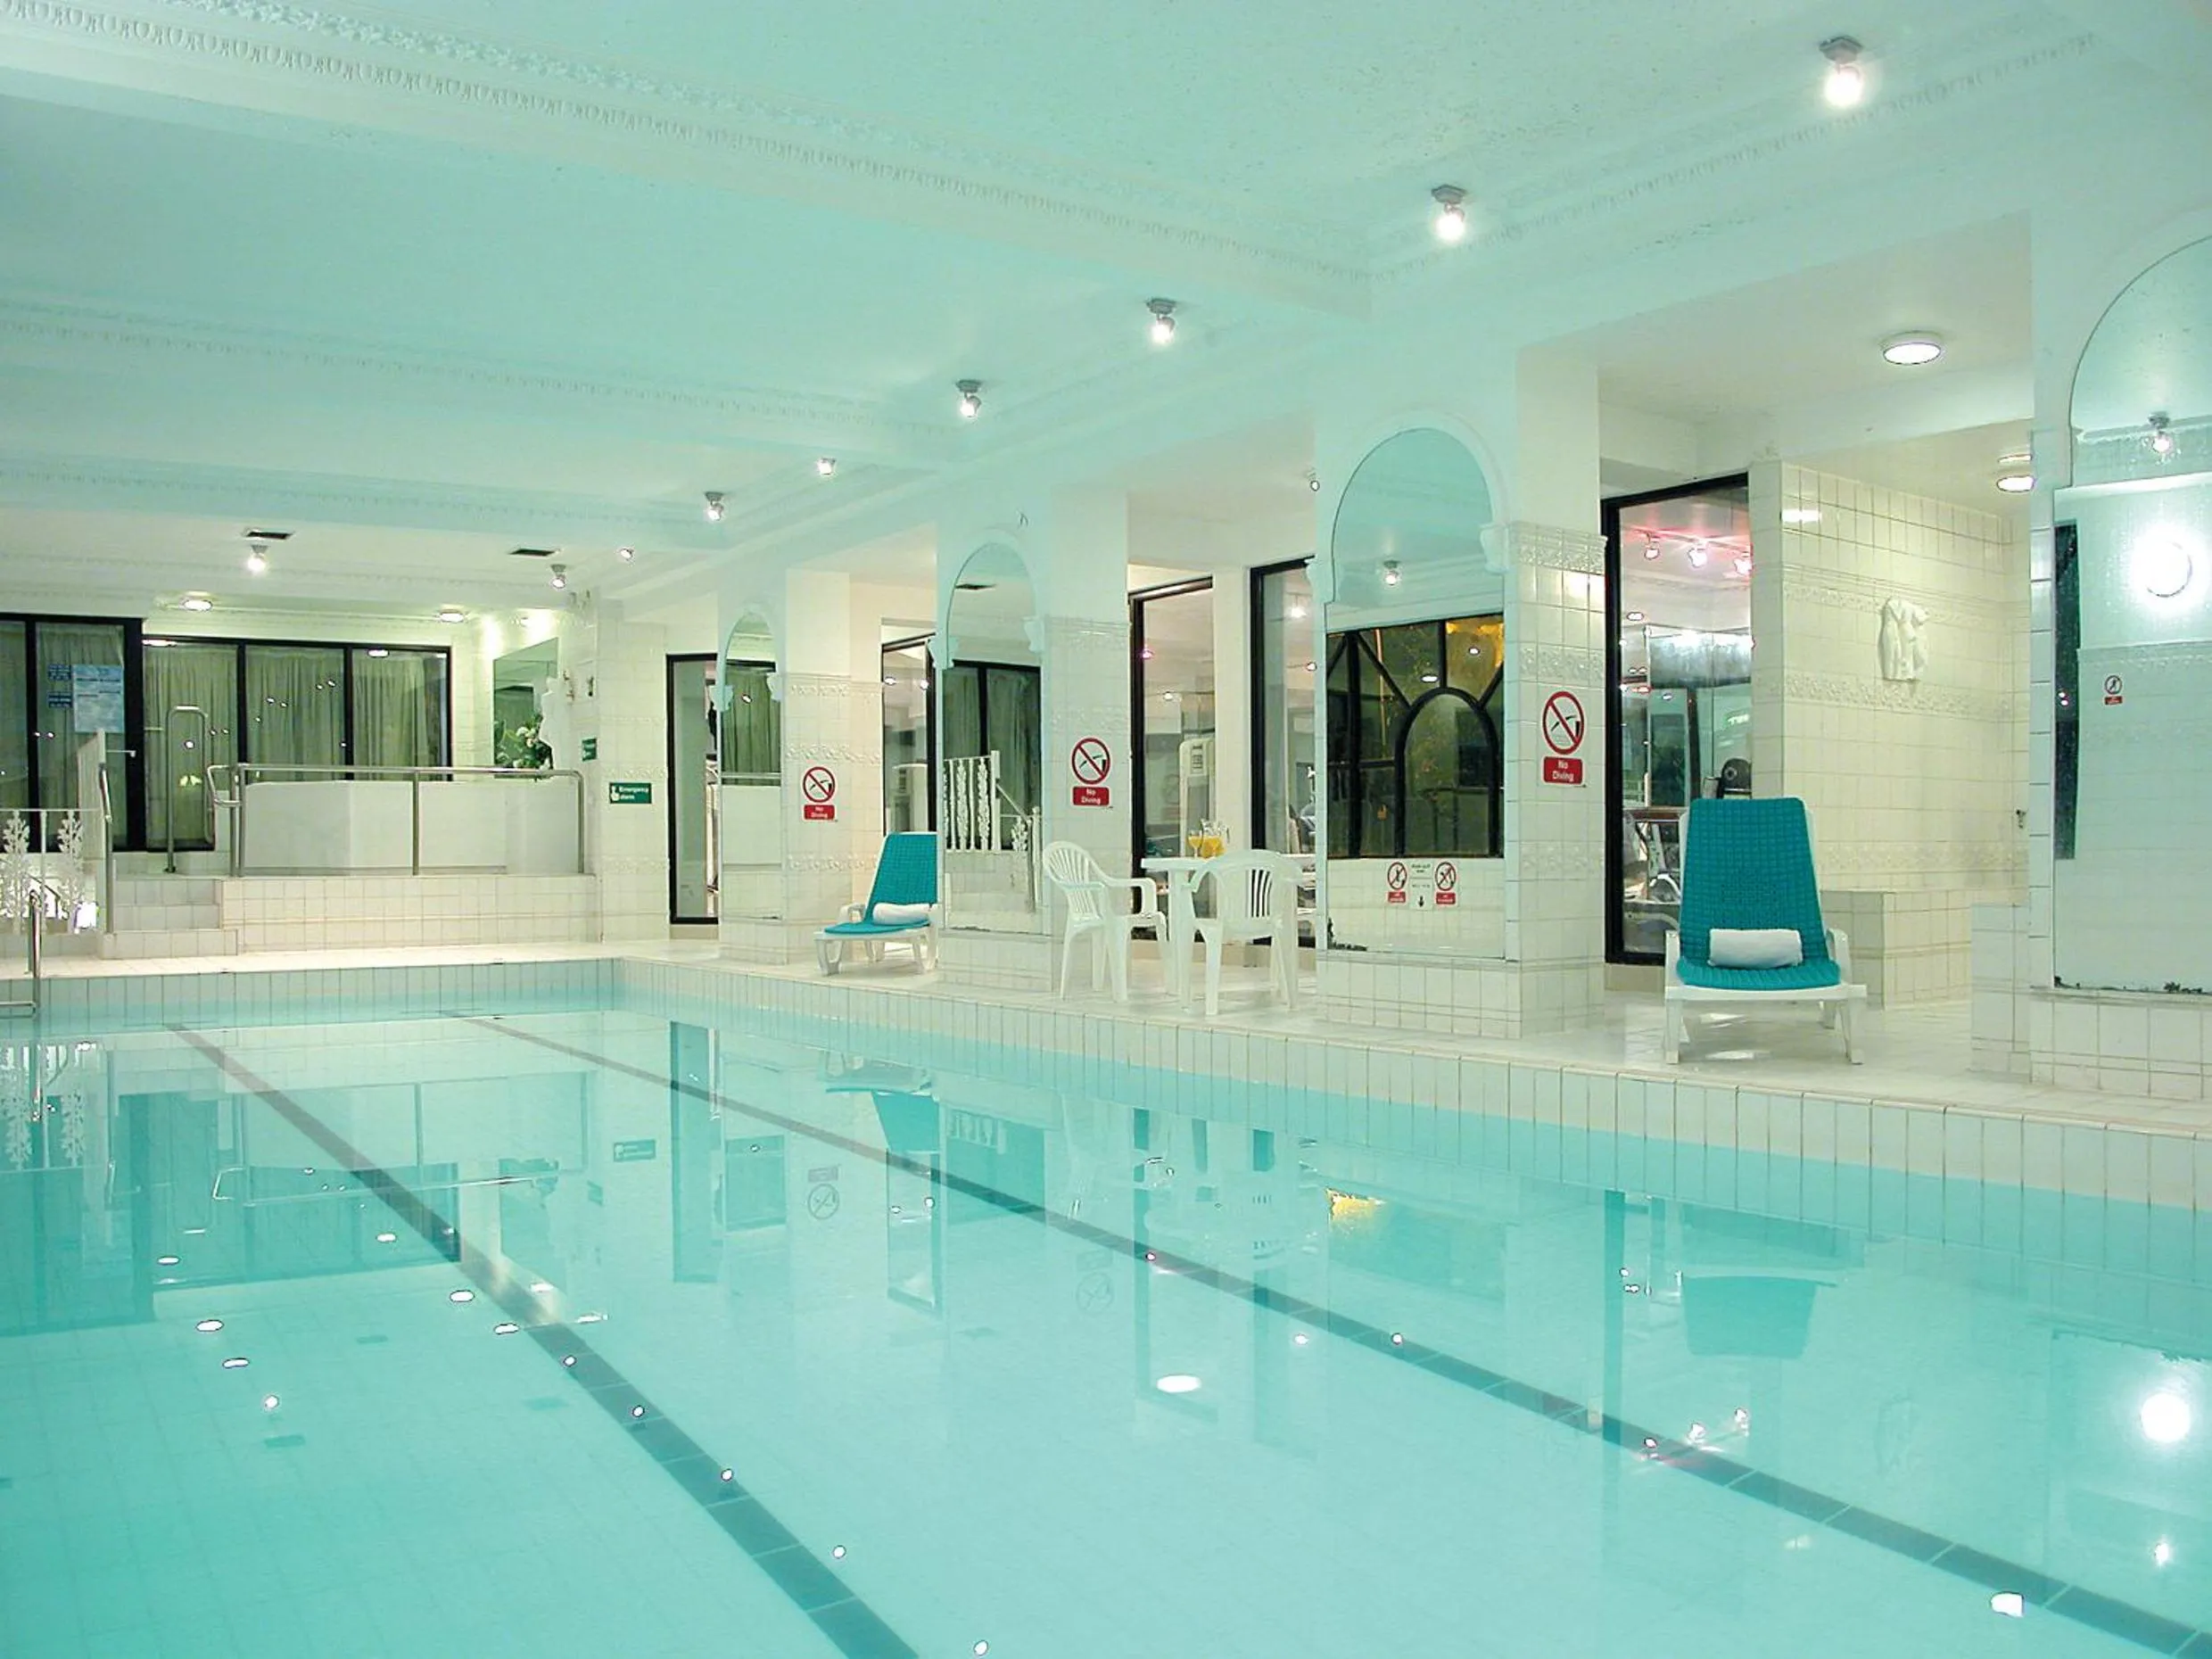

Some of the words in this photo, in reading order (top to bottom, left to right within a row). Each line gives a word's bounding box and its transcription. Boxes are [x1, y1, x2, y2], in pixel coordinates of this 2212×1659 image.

[1558, 760, 1568, 769] No
[1552, 771, 1574, 782] Diving
[1081, 796, 1101, 805] Diving
